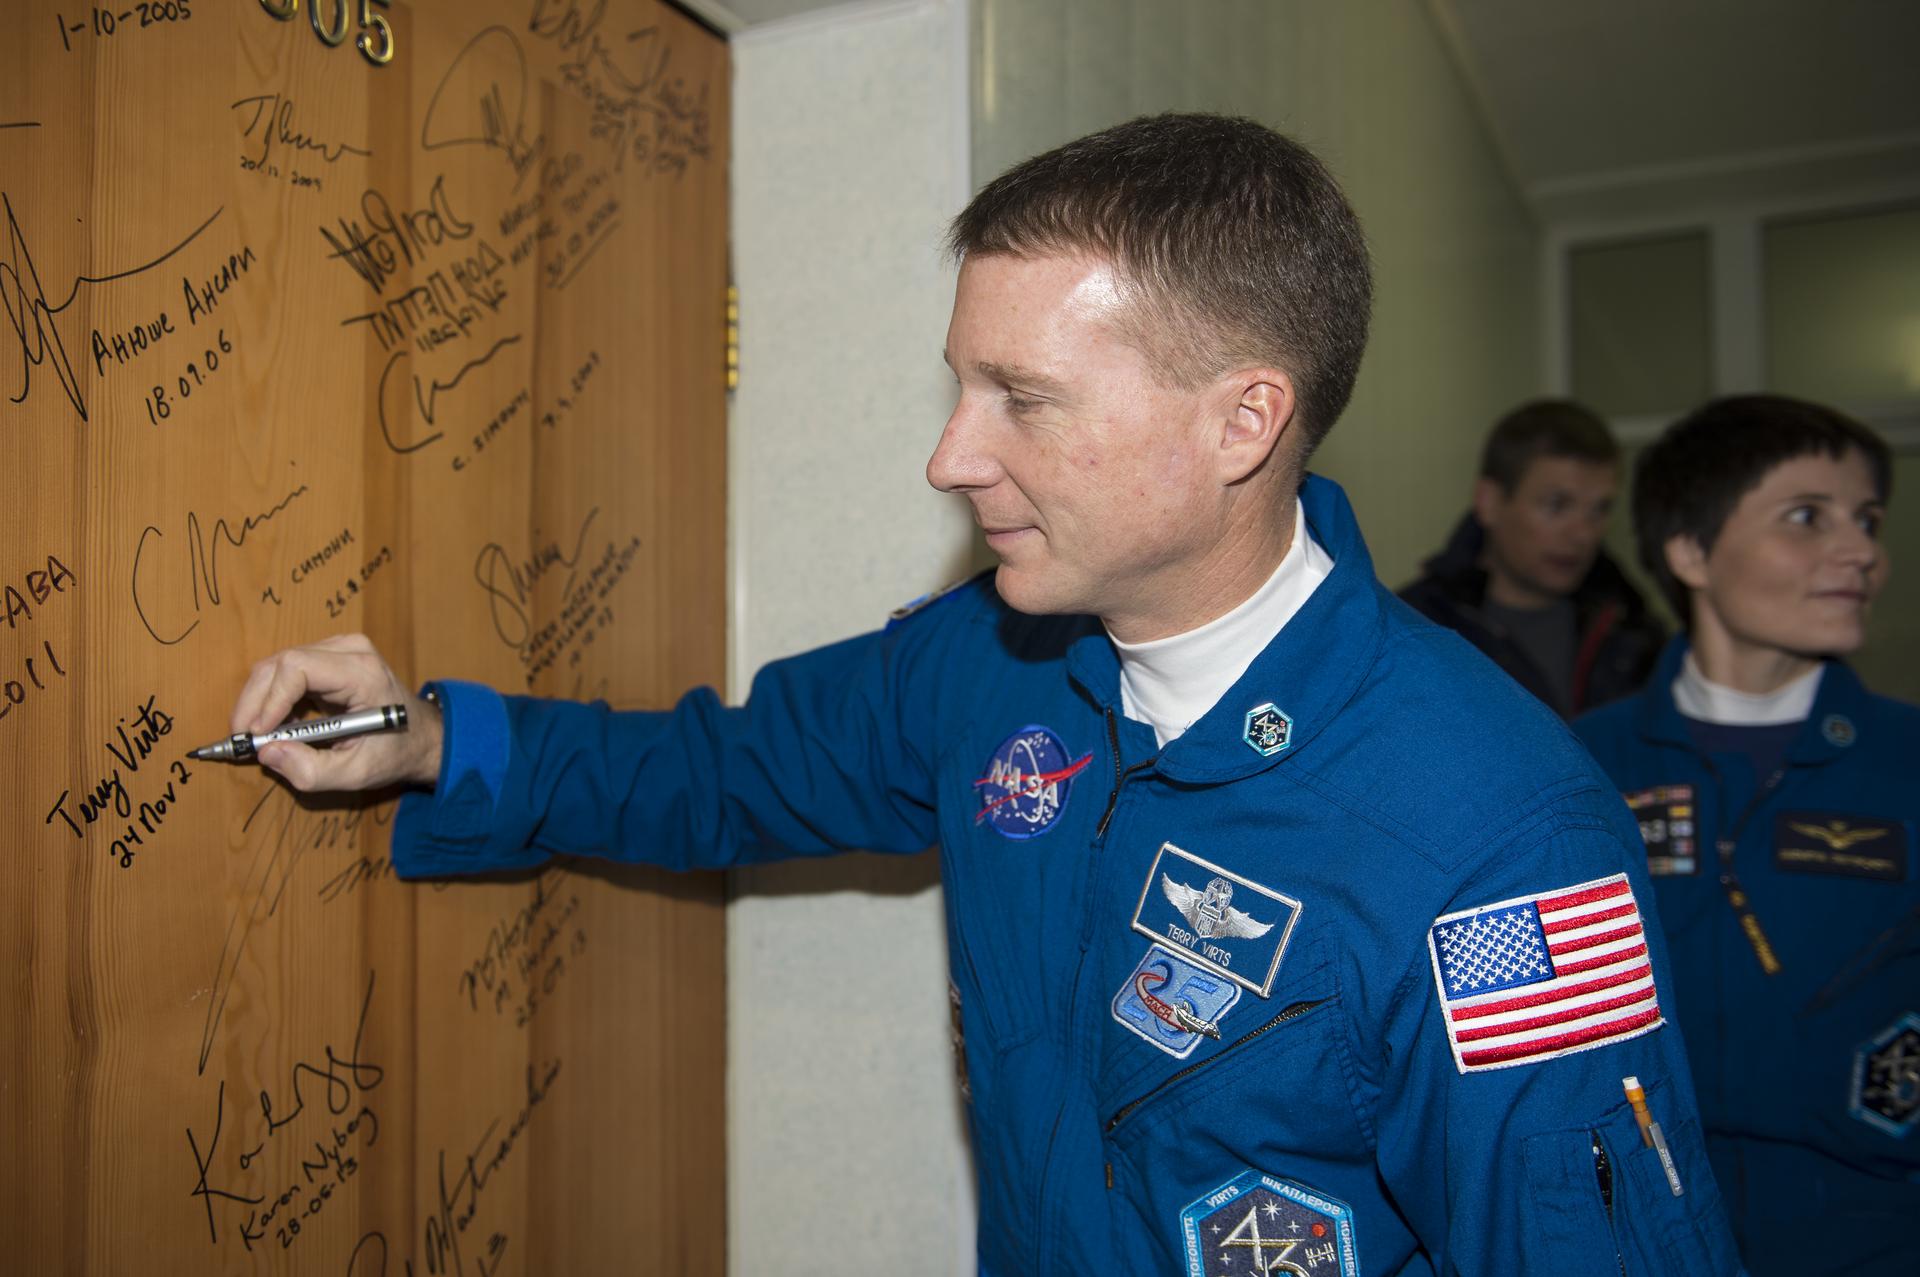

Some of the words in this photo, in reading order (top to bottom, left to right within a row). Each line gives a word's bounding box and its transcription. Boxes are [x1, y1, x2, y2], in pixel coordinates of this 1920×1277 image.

[57, 0, 191, 51] 1-10-2005
[258, 0, 394, 66] 05
[0, 641, 66, 720] 011
[988, 757, 1060, 809] NASA
[110, 825, 143, 869] 24
[1167, 923, 1199, 949] TERRY
[1202, 941, 1232, 967] VIRTS
[1143, 996, 1173, 1020] MACH
[240, 1185, 300, 1251] Karen
[1205, 1185, 1240, 1209] VIRTS
